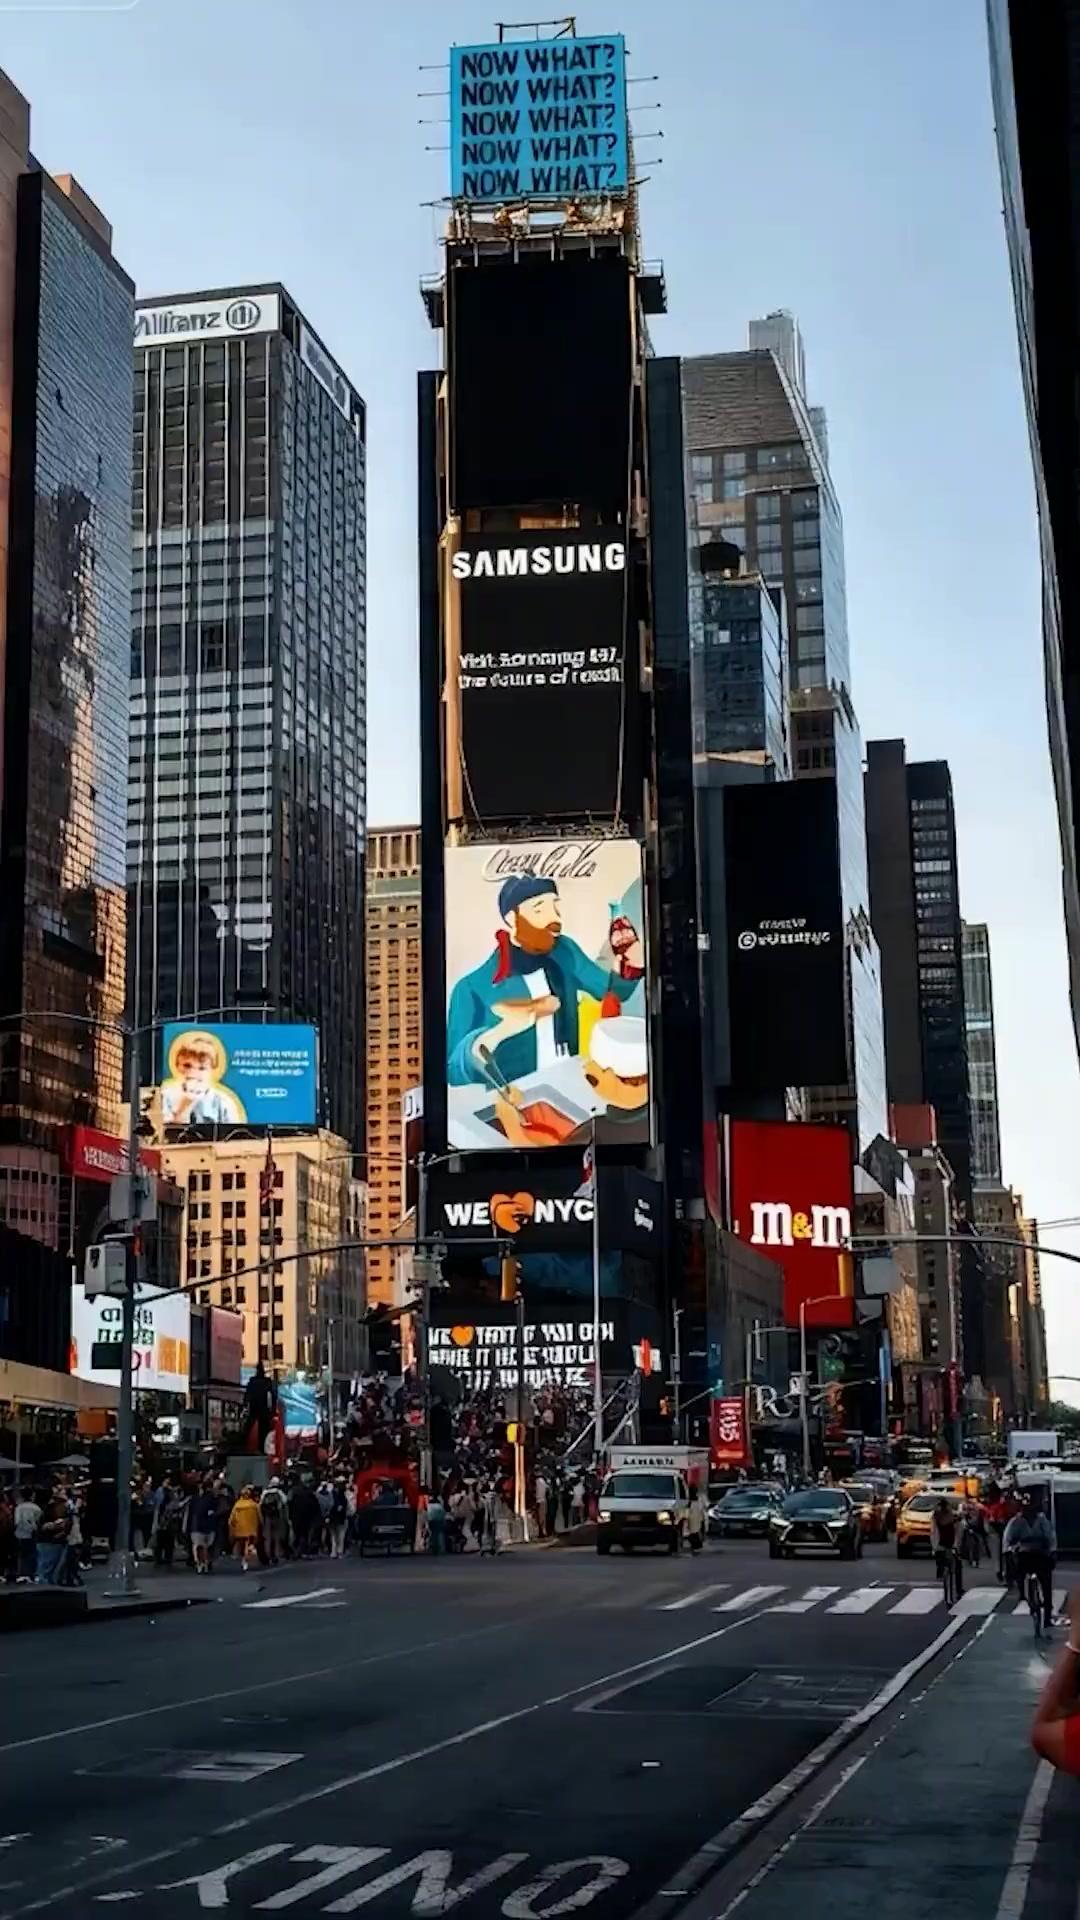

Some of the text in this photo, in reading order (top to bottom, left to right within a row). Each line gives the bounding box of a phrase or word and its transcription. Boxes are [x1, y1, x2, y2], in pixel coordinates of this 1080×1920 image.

[461, 44, 616, 79] NOW WHAT?
[461, 72, 616, 106] NOW WHAT?
[461, 103, 616, 137] NOW WHAT?
[461, 133, 617, 166] NOW WHAT?
[463, 163, 617, 198] NOW WHAT?
[134, 309, 222, 337] Allianz
[452, 543, 625, 579] SAMSUNG
[444, 1199, 595, 1226] WE NYC
[155, 1843, 630, 1920] ONLY
